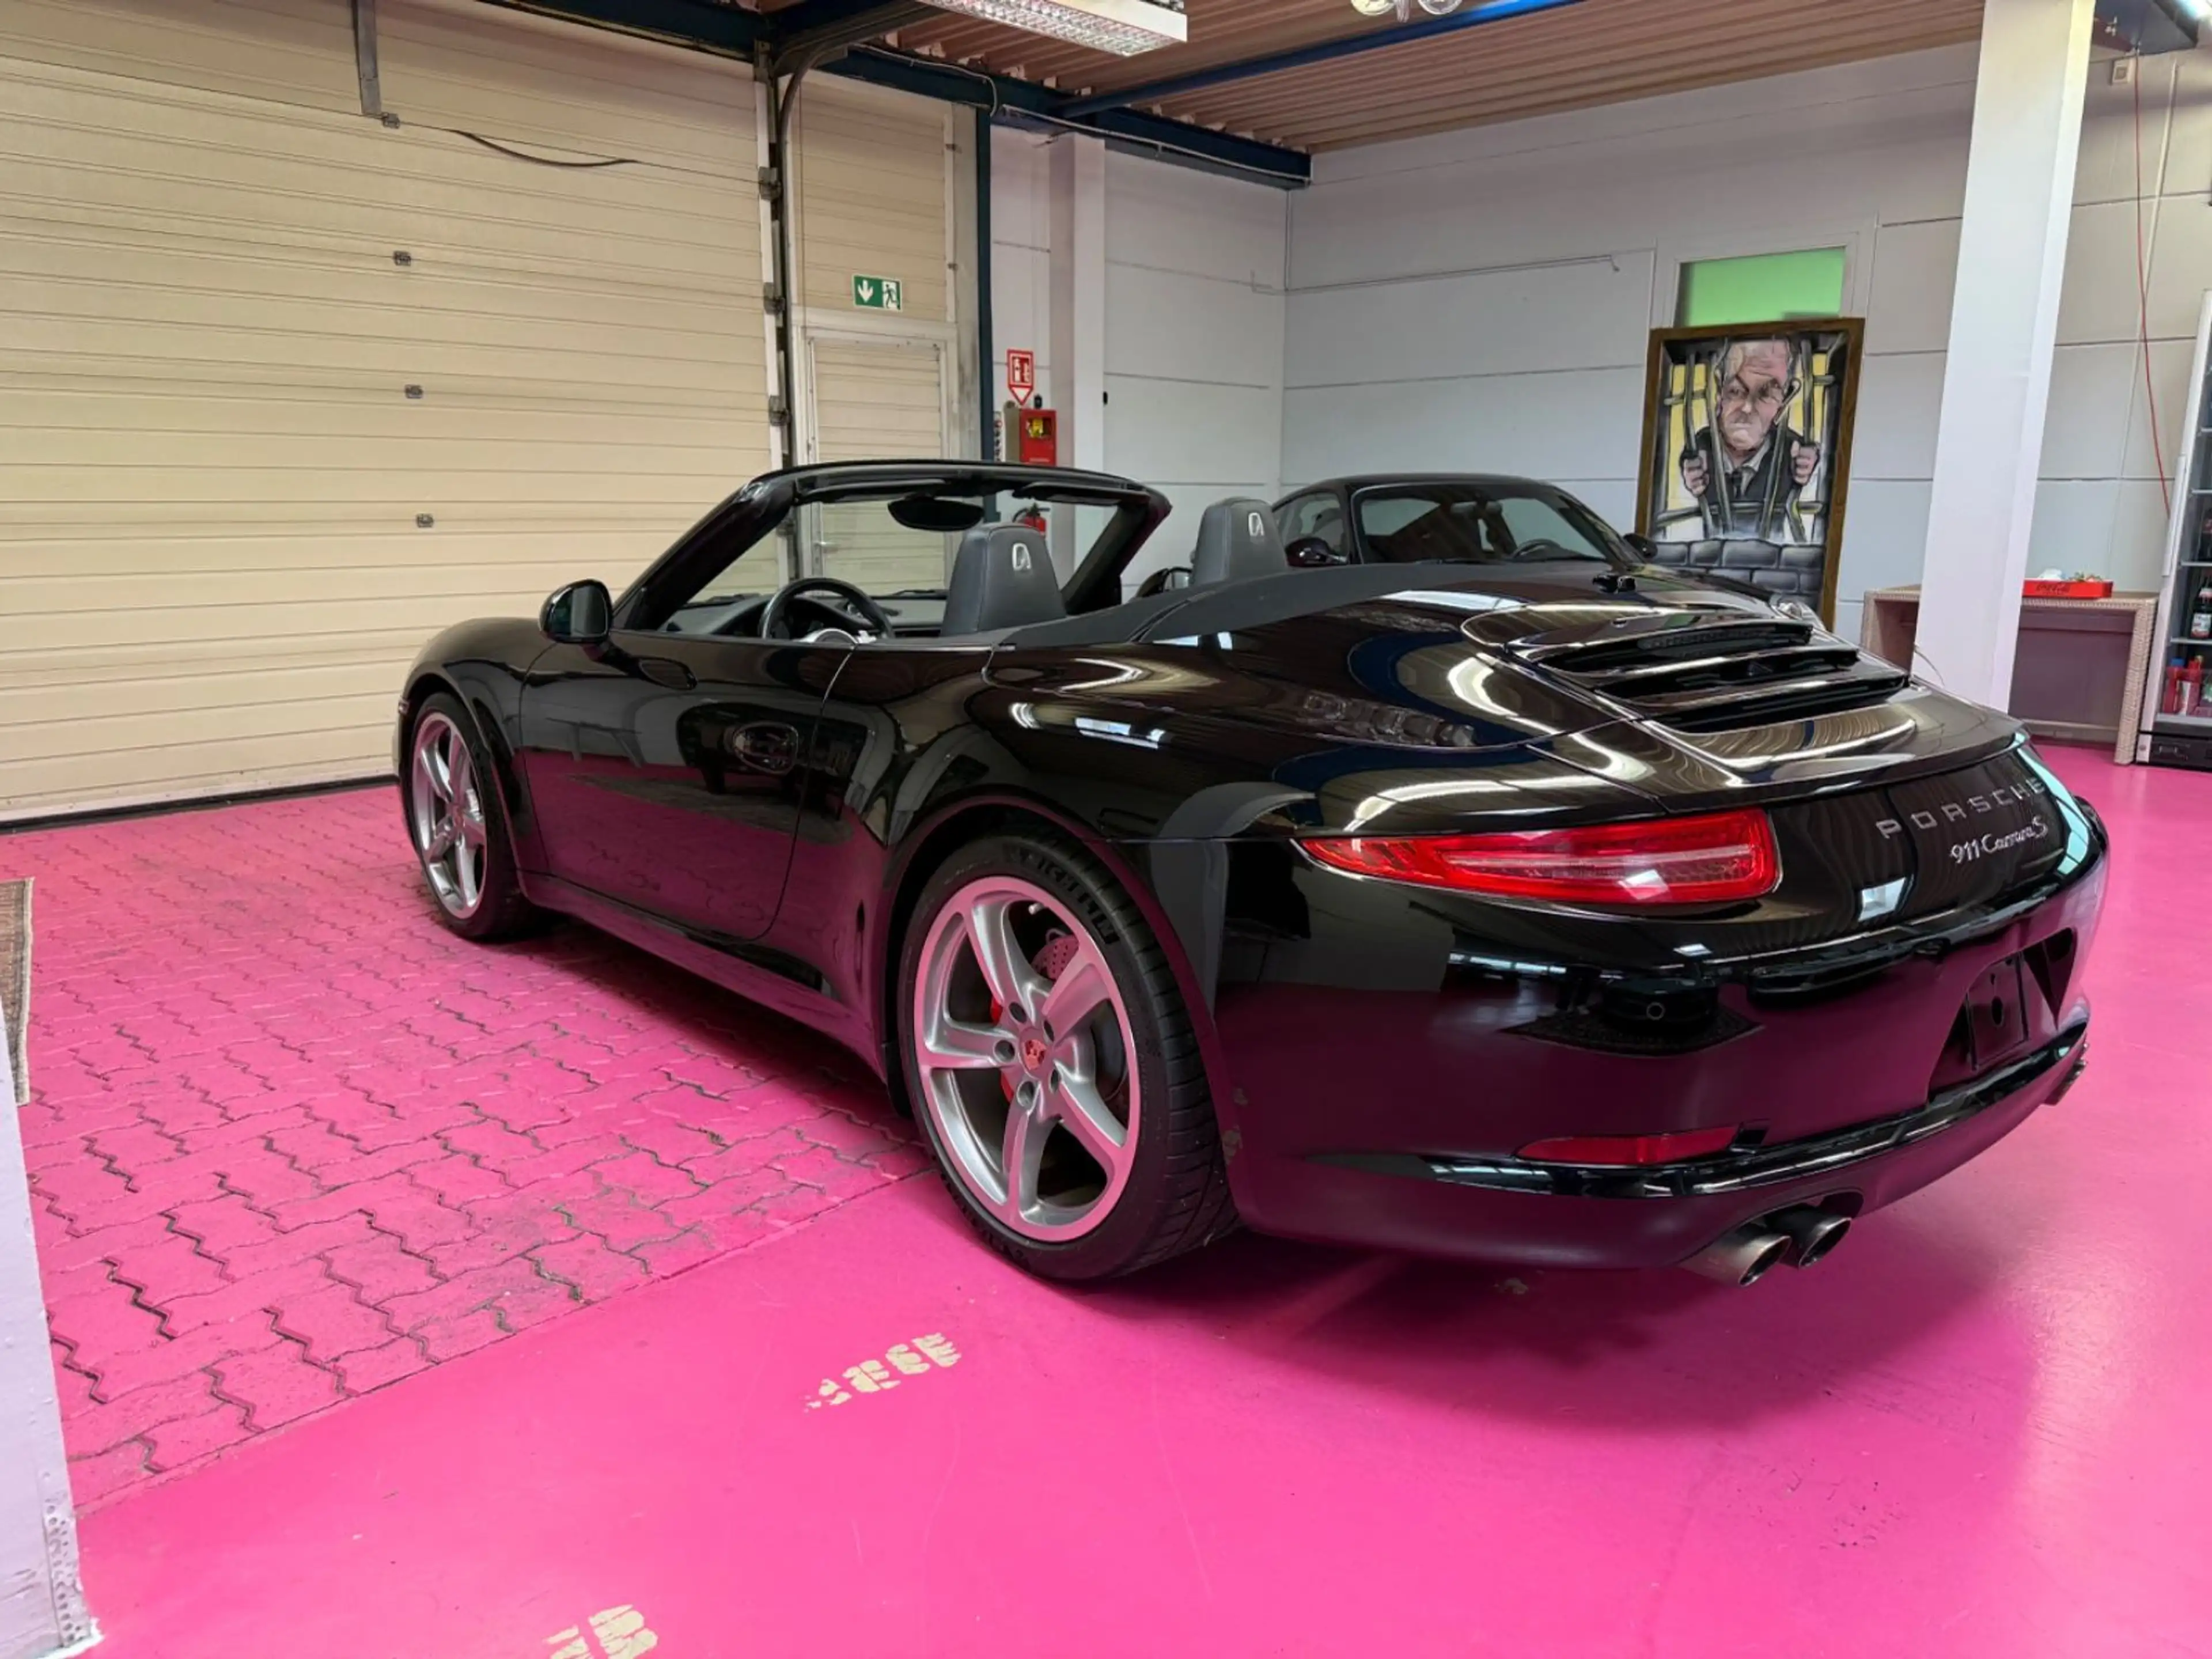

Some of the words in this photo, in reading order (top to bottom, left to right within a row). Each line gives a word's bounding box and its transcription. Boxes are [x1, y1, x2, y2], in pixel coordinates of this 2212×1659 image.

[1875, 777, 2046, 839] PORSCHE
[1949, 839, 1980, 864] 911
[2032, 815, 2048, 839] S
